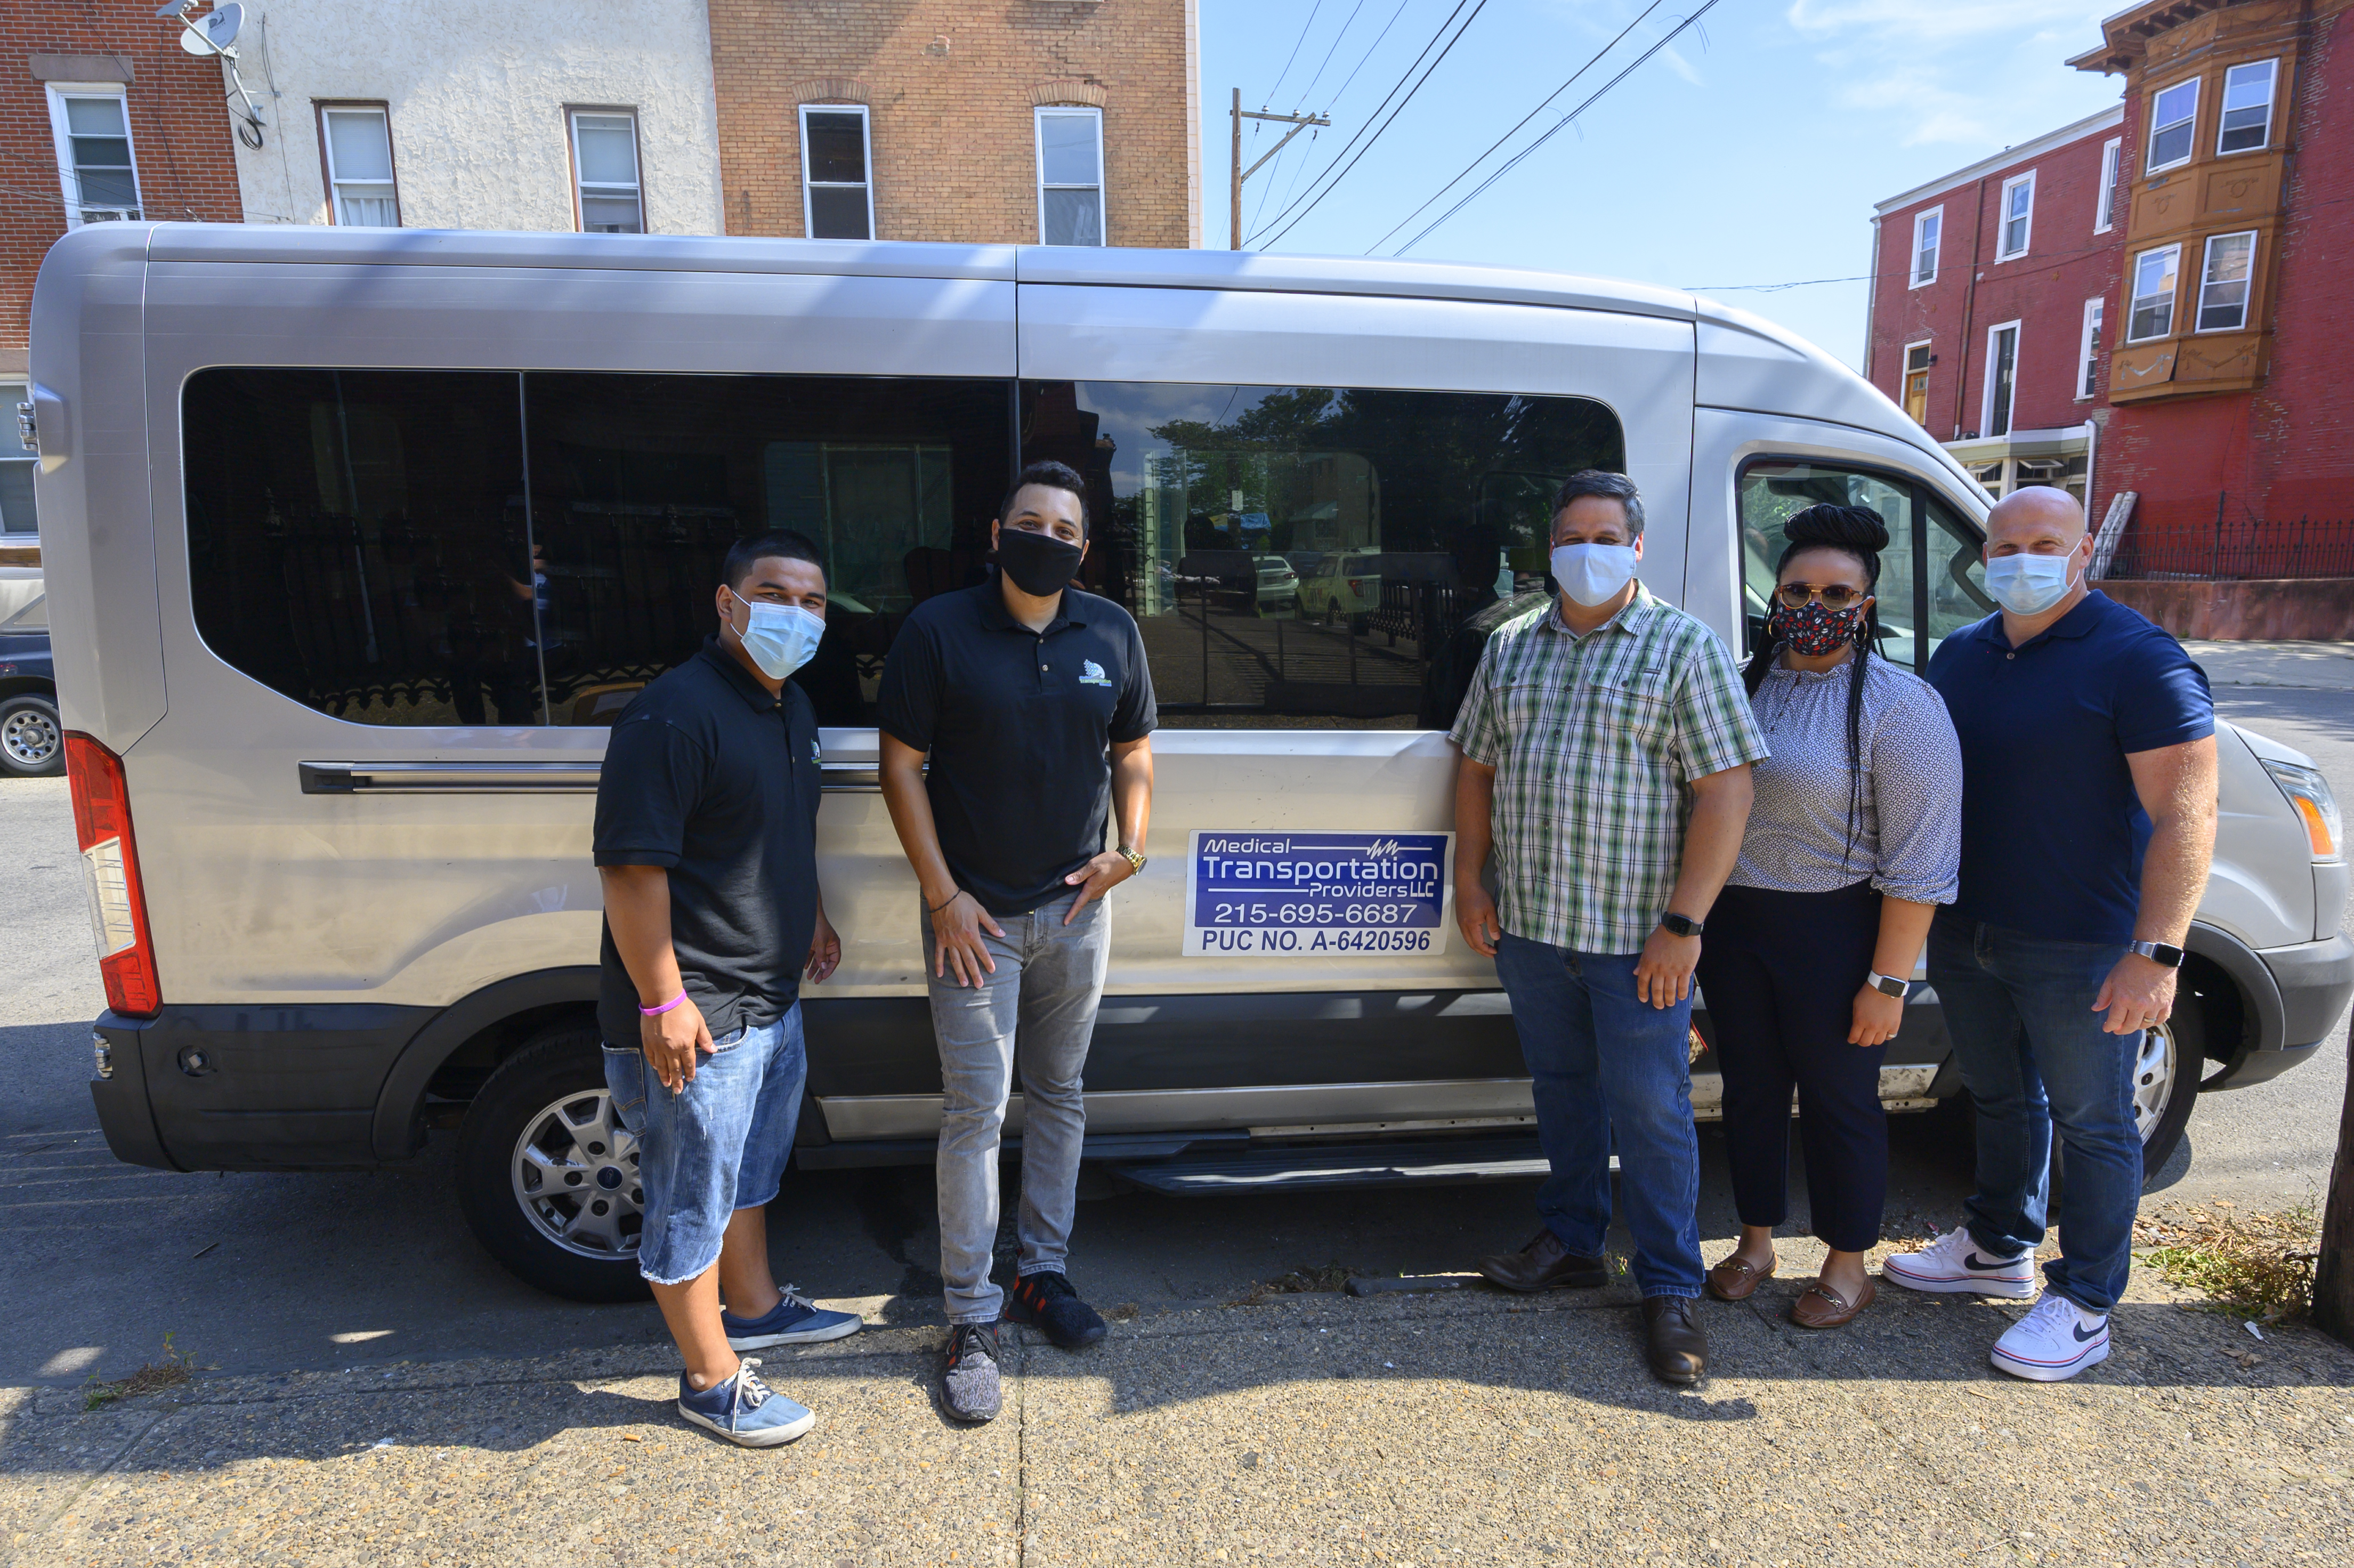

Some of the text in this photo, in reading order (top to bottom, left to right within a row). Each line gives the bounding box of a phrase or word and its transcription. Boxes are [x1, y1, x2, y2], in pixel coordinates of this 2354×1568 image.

[1203, 838, 1290, 853] Medical
[1203, 856, 1438, 885] Transportation
[1309, 882, 1434, 898] Providers LLC
[1214, 903, 1418, 924] 215-695-6687
[1202, 930, 1431, 951] PUC NO. A-6420596
